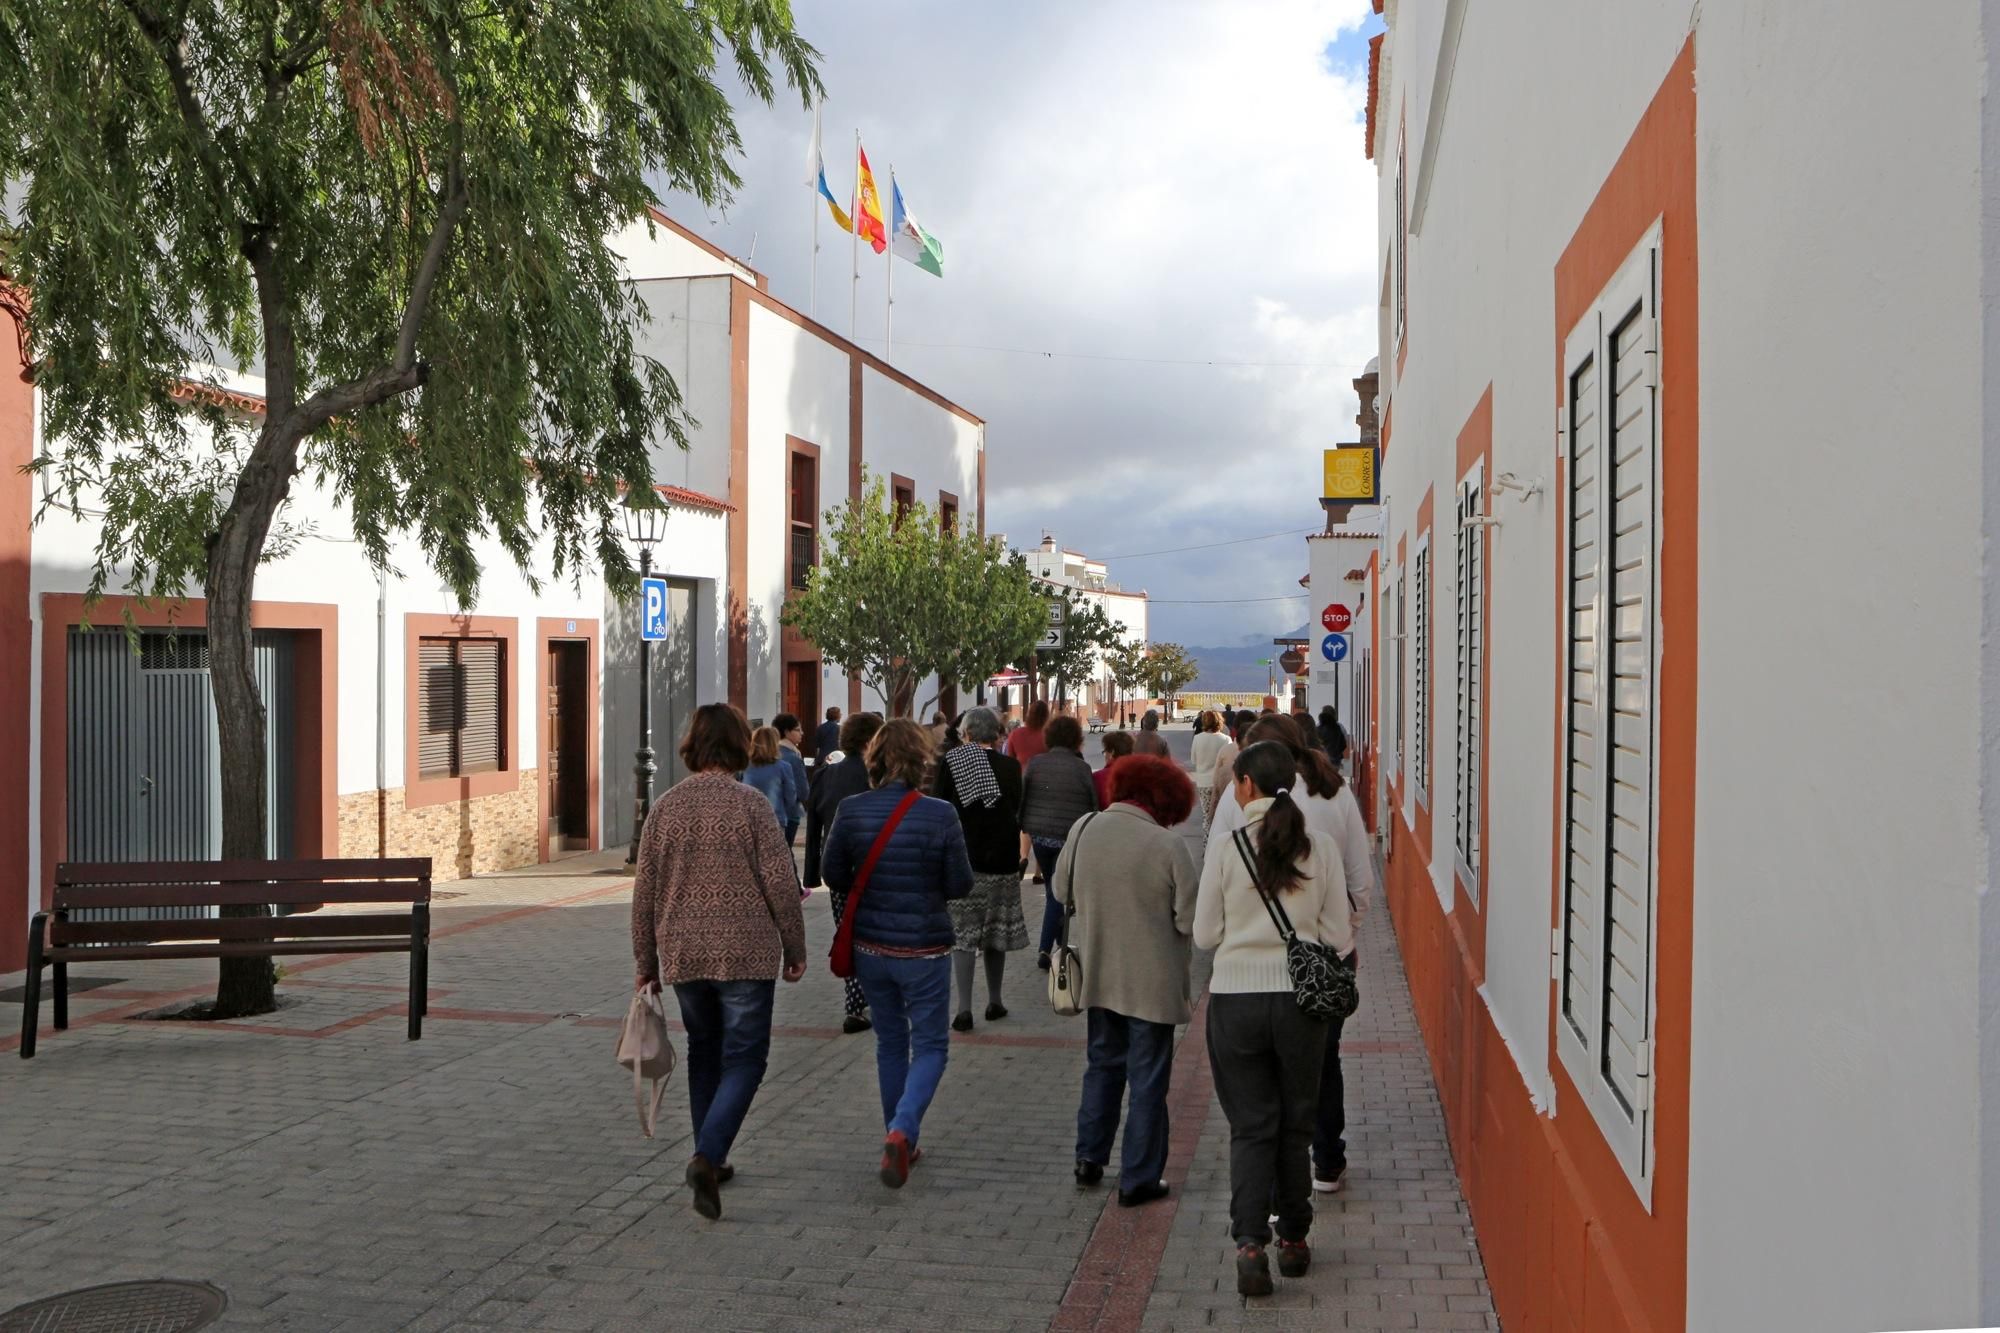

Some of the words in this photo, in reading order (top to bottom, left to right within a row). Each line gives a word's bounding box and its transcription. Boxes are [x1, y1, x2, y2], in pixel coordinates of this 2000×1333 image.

[1361, 451, 1370, 495] CORREOS
[647, 586, 661, 632] P
[1324, 614, 1349, 622] STOP
